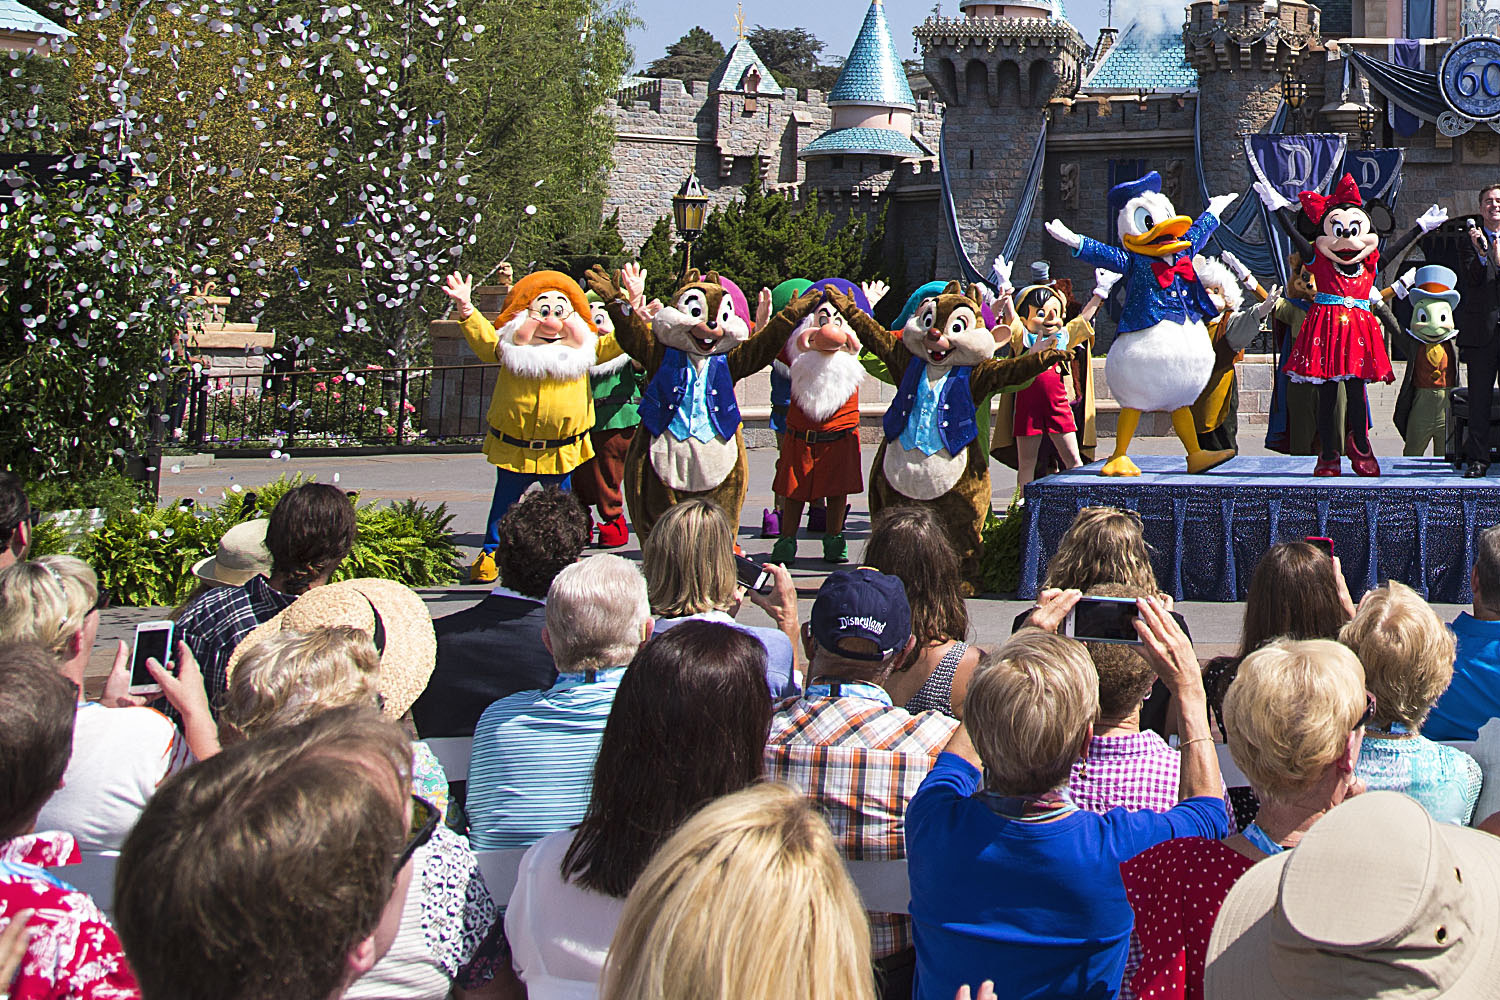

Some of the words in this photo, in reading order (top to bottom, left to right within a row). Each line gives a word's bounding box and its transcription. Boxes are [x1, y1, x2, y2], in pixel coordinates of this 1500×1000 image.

[1279, 142, 1312, 187] D
[1356, 156, 1381, 189] D
[839, 616, 887, 633] Disneyland
